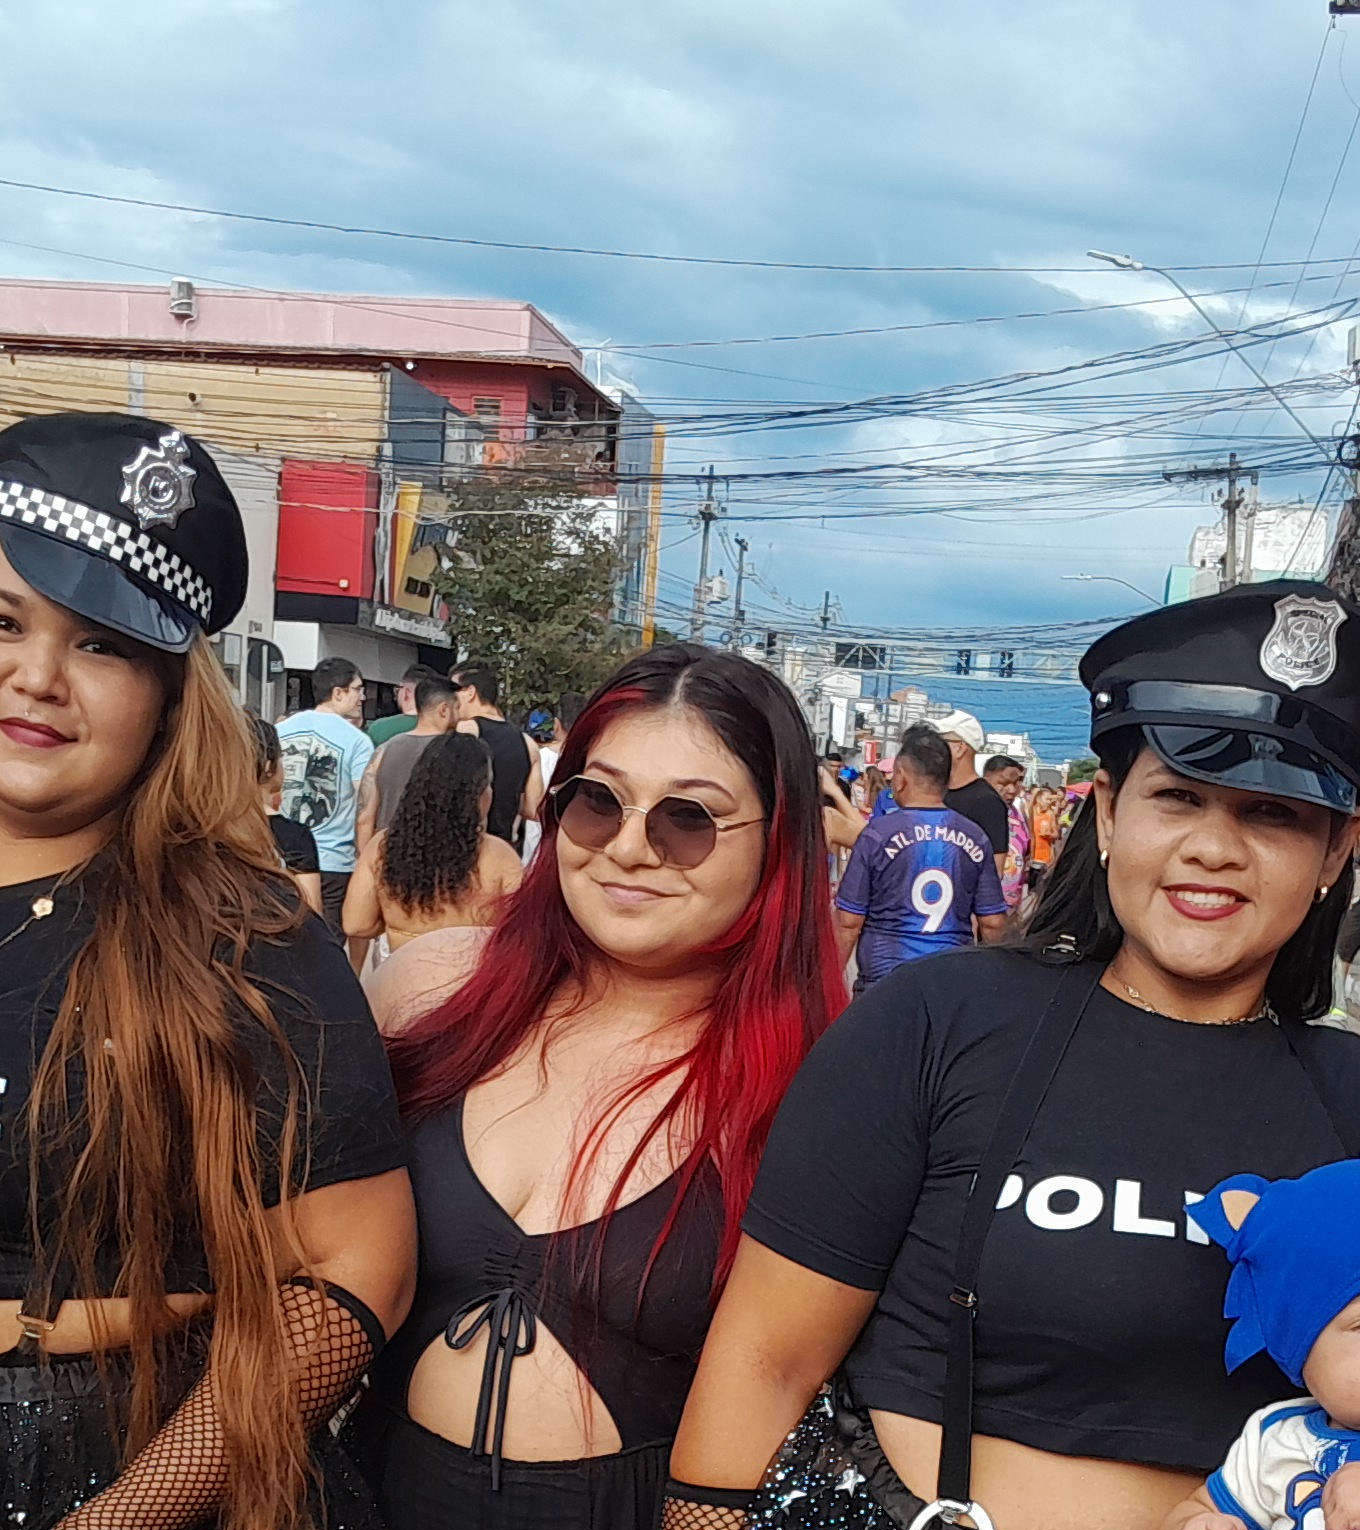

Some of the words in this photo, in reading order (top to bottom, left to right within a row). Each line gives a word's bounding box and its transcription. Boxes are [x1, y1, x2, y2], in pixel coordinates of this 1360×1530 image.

[884, 832, 915, 860] ATL.
[914, 824, 932, 842] DE
[934, 825, 985, 863] MADRID
[911, 869, 954, 933] 9
